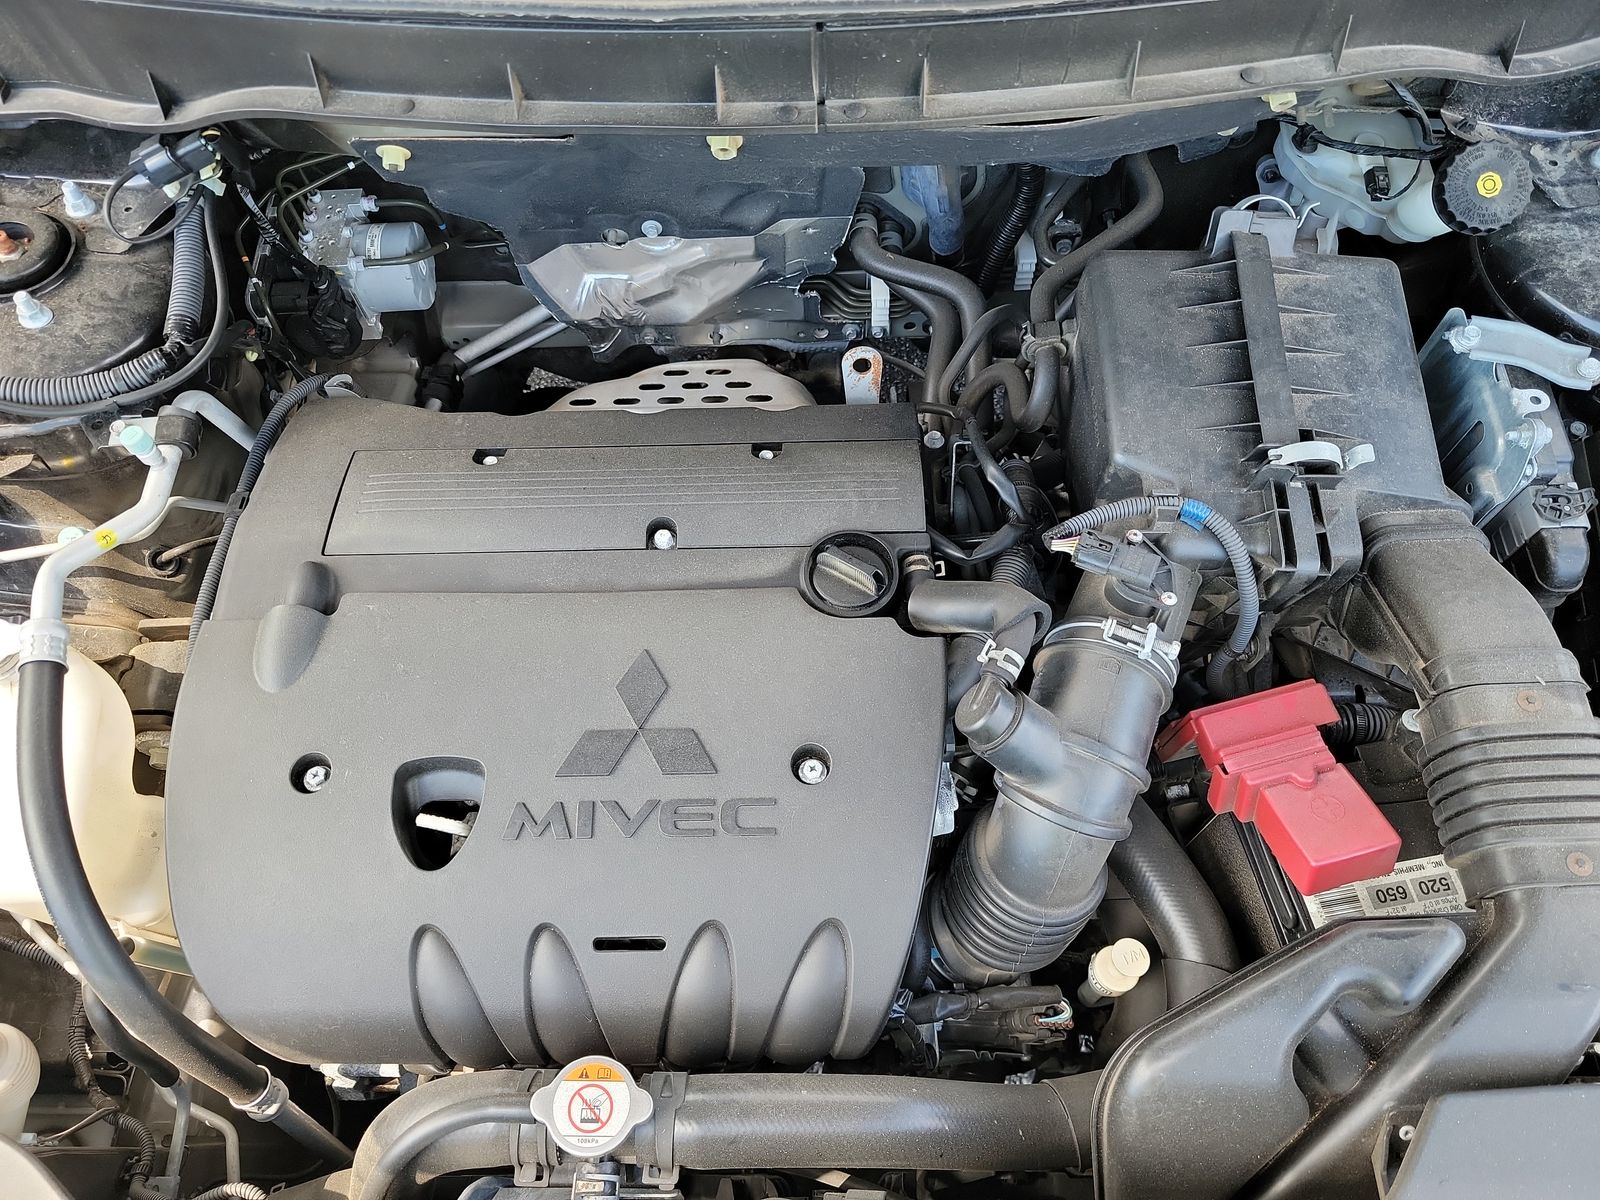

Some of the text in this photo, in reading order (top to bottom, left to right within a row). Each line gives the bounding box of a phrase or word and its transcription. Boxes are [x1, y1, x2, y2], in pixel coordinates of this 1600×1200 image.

[502, 798, 777, 840] MIVEC
[1376, 885, 1408, 904] 650
[1418, 877, 1451, 895] 520
